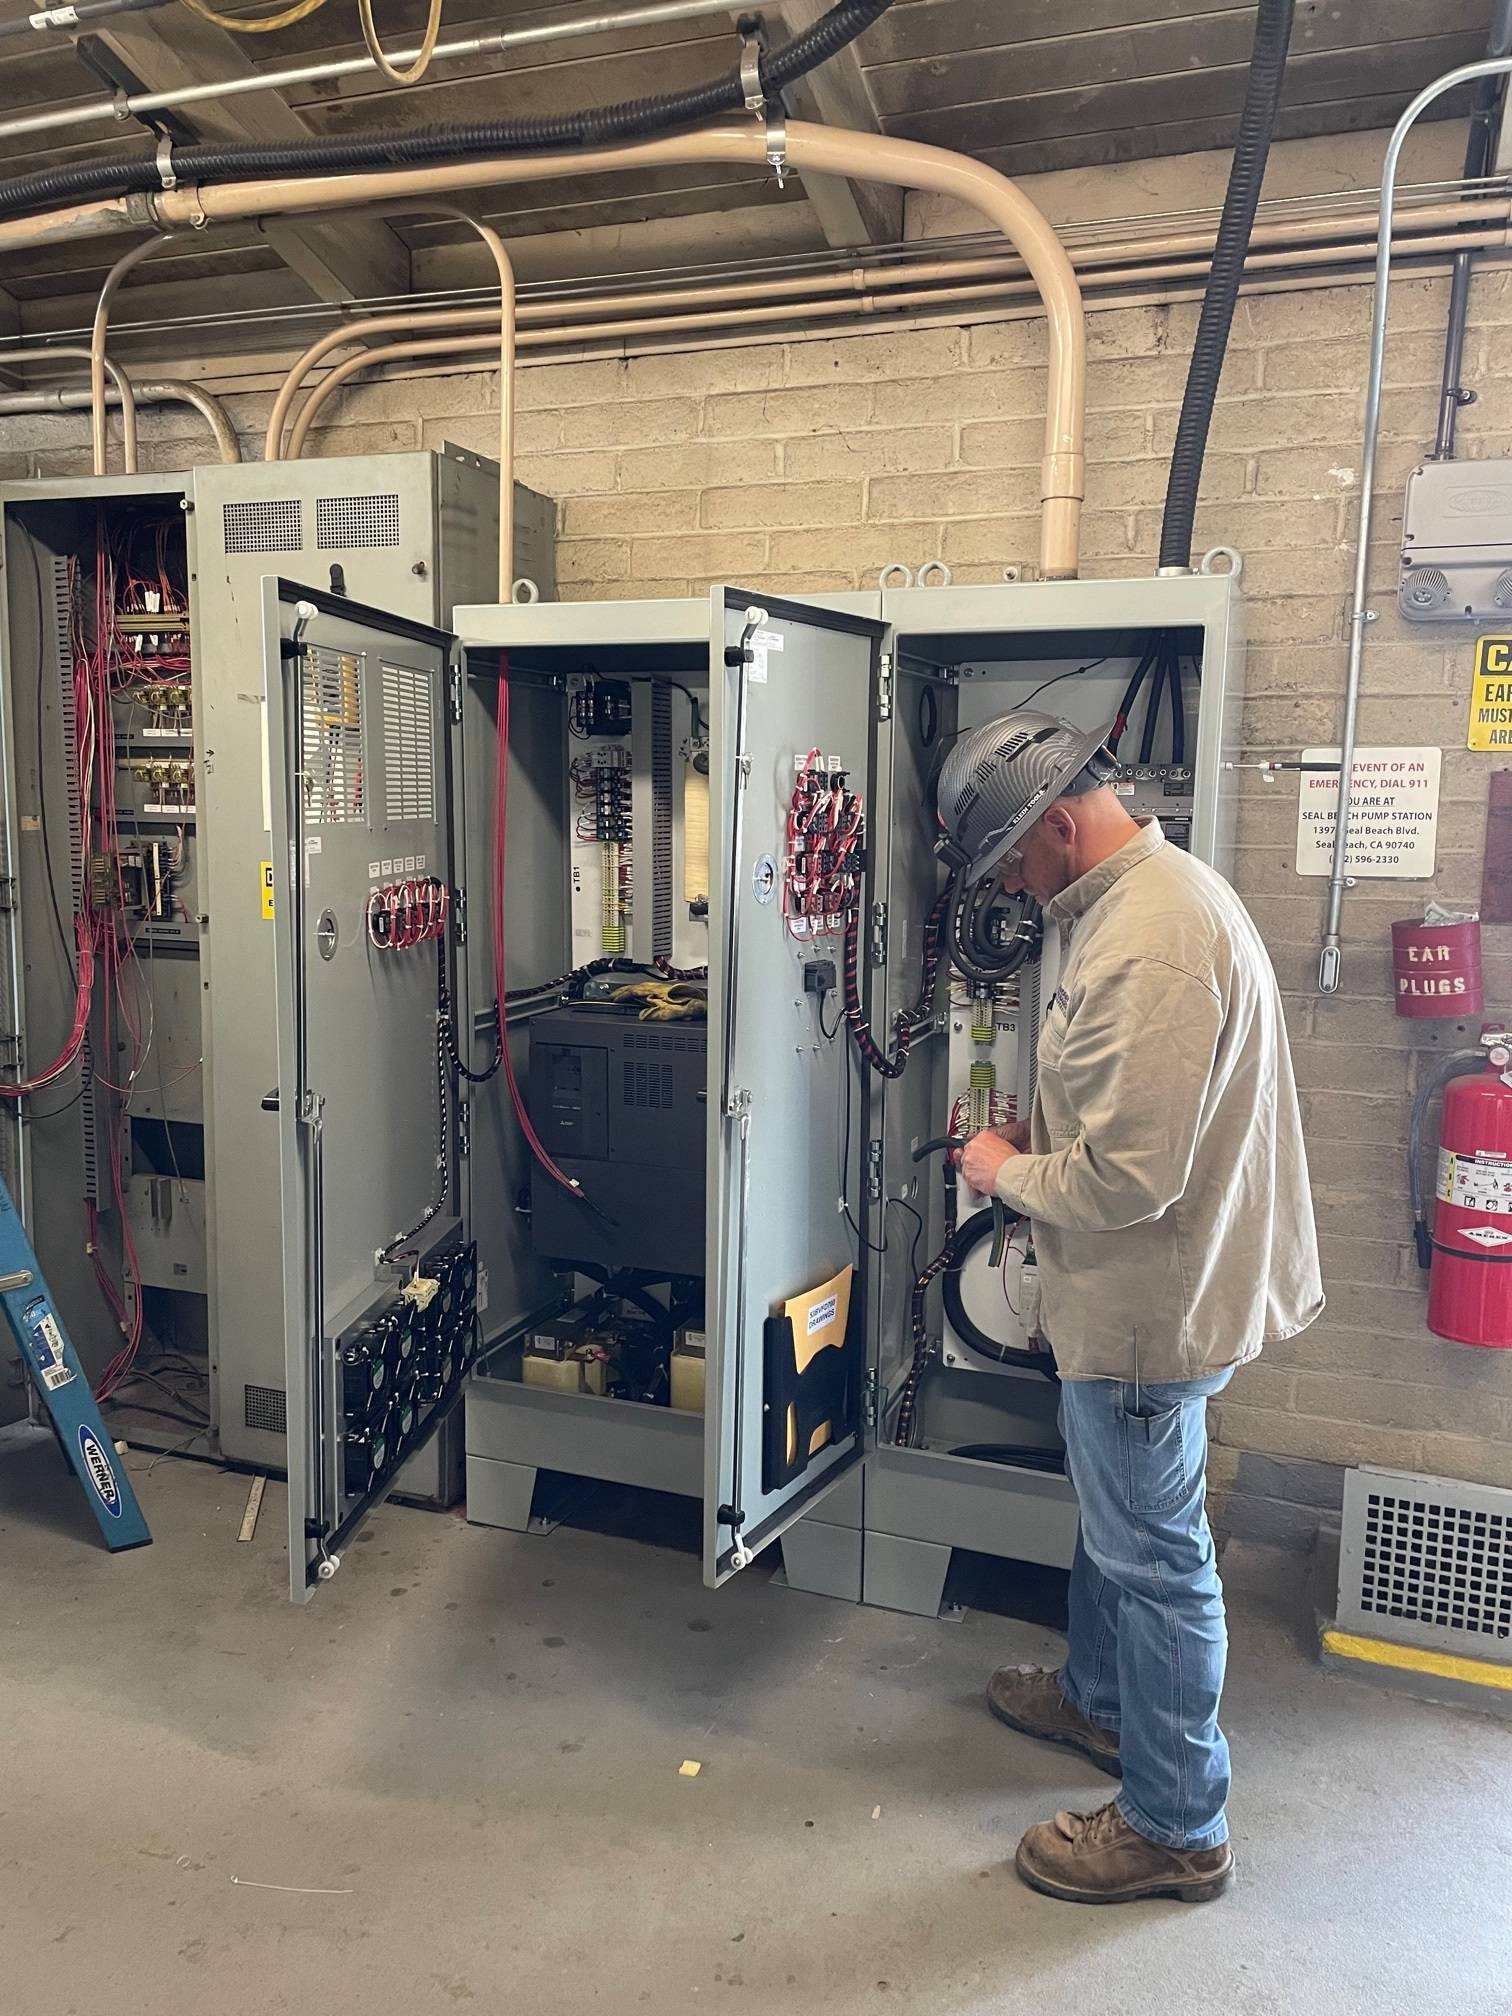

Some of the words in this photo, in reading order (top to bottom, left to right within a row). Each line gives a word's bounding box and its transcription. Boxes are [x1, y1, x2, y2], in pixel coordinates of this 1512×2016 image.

[1487, 644, 1512, 671] C
[1352, 763, 1388, 772] EVENT
[1390, 763, 1406, 772] OF
[1408, 763, 1425, 772] AN
[1380, 779, 1406, 788] DIAL
[1409, 779, 1428, 788] 911
[1362, 797, 1381, 806] ARE
[1383, 797, 1395, 806] AT
[1302, 811, 1325, 820] SEAL
[1361, 812, 1390, 821] PUMP
[1391, 812, 1433, 821] STATION
[1365, 826, 1393, 835] Beach
[1395, 826, 1420, 835] Blvd.
[1315, 840, 1335, 849] Seal
[1345, 840, 1368, 850] each,
[1369, 841, 1383, 849] CA
[1385, 841, 1415, 849] 90740
[1355, 855, 1399, 864] 596-2330
[1407, 945, 1450, 962] EAR
[1400, 977, 1466, 993] PLUGS
[996, 1022, 1016, 1032] TB3
[86, 1444, 115, 1500] WERNER
